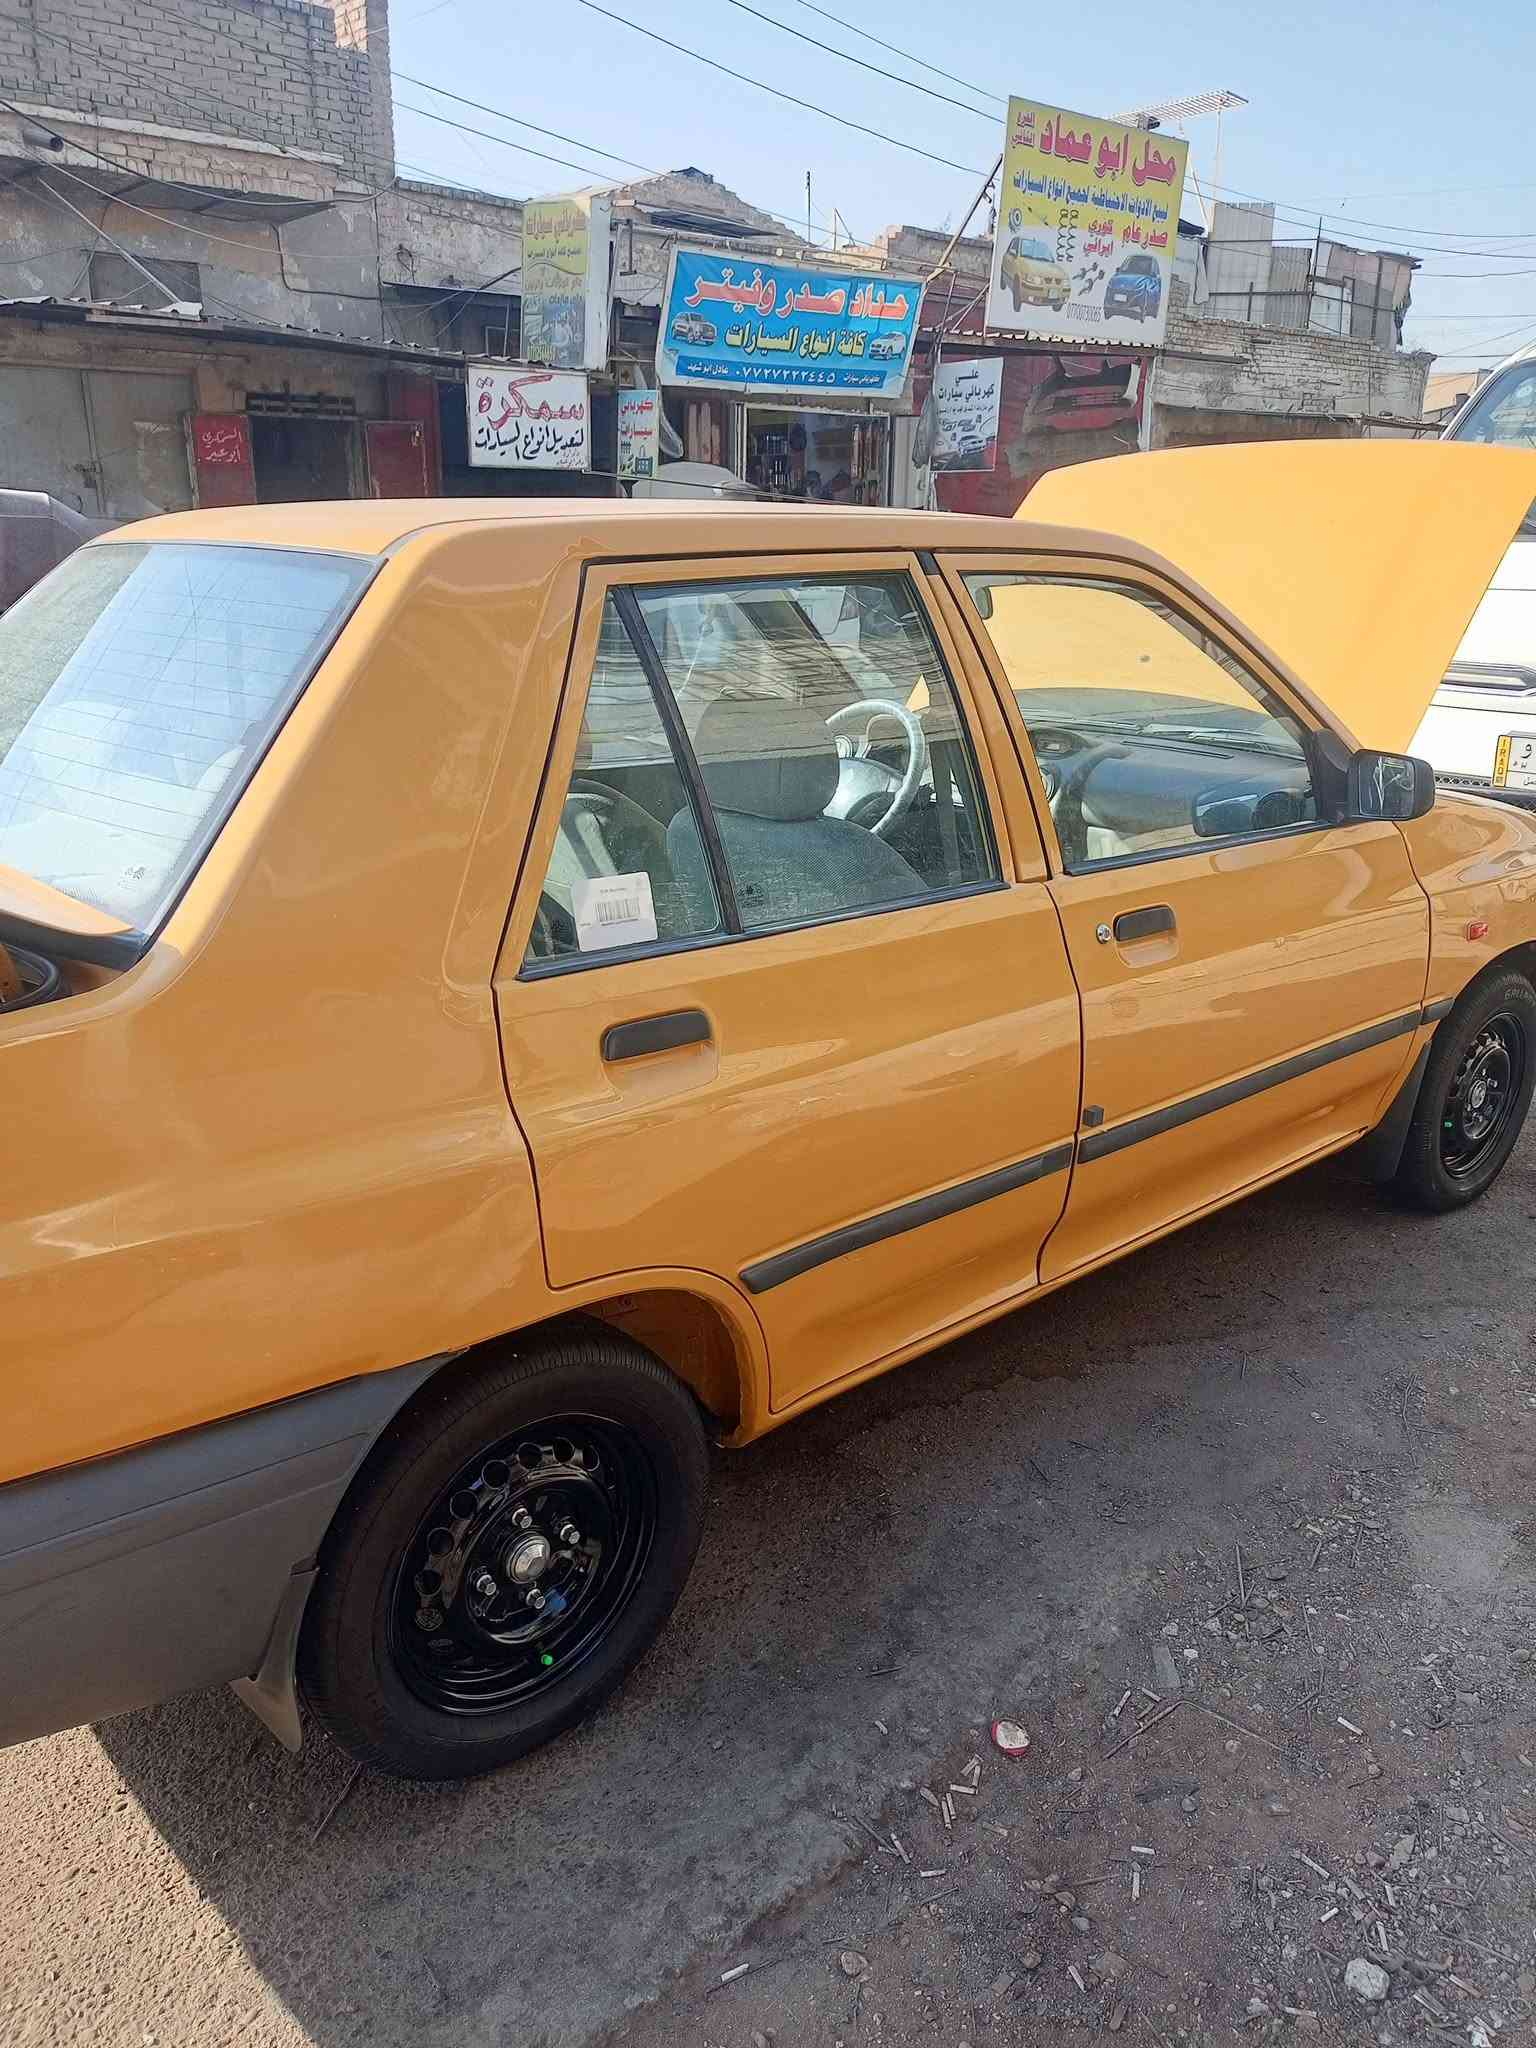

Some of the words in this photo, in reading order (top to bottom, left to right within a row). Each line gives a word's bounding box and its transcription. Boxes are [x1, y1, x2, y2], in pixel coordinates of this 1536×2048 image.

[1132, 139, 1177, 187] محل
[776, 282, 847, 319] صدر
[848, 283, 909, 320] حداد
[724, 321, 799, 358] السيارات
[799, 329, 836, 360] انواع
[837, 328, 868, 359] كافة
[476, 374, 585, 431] سمكرة
